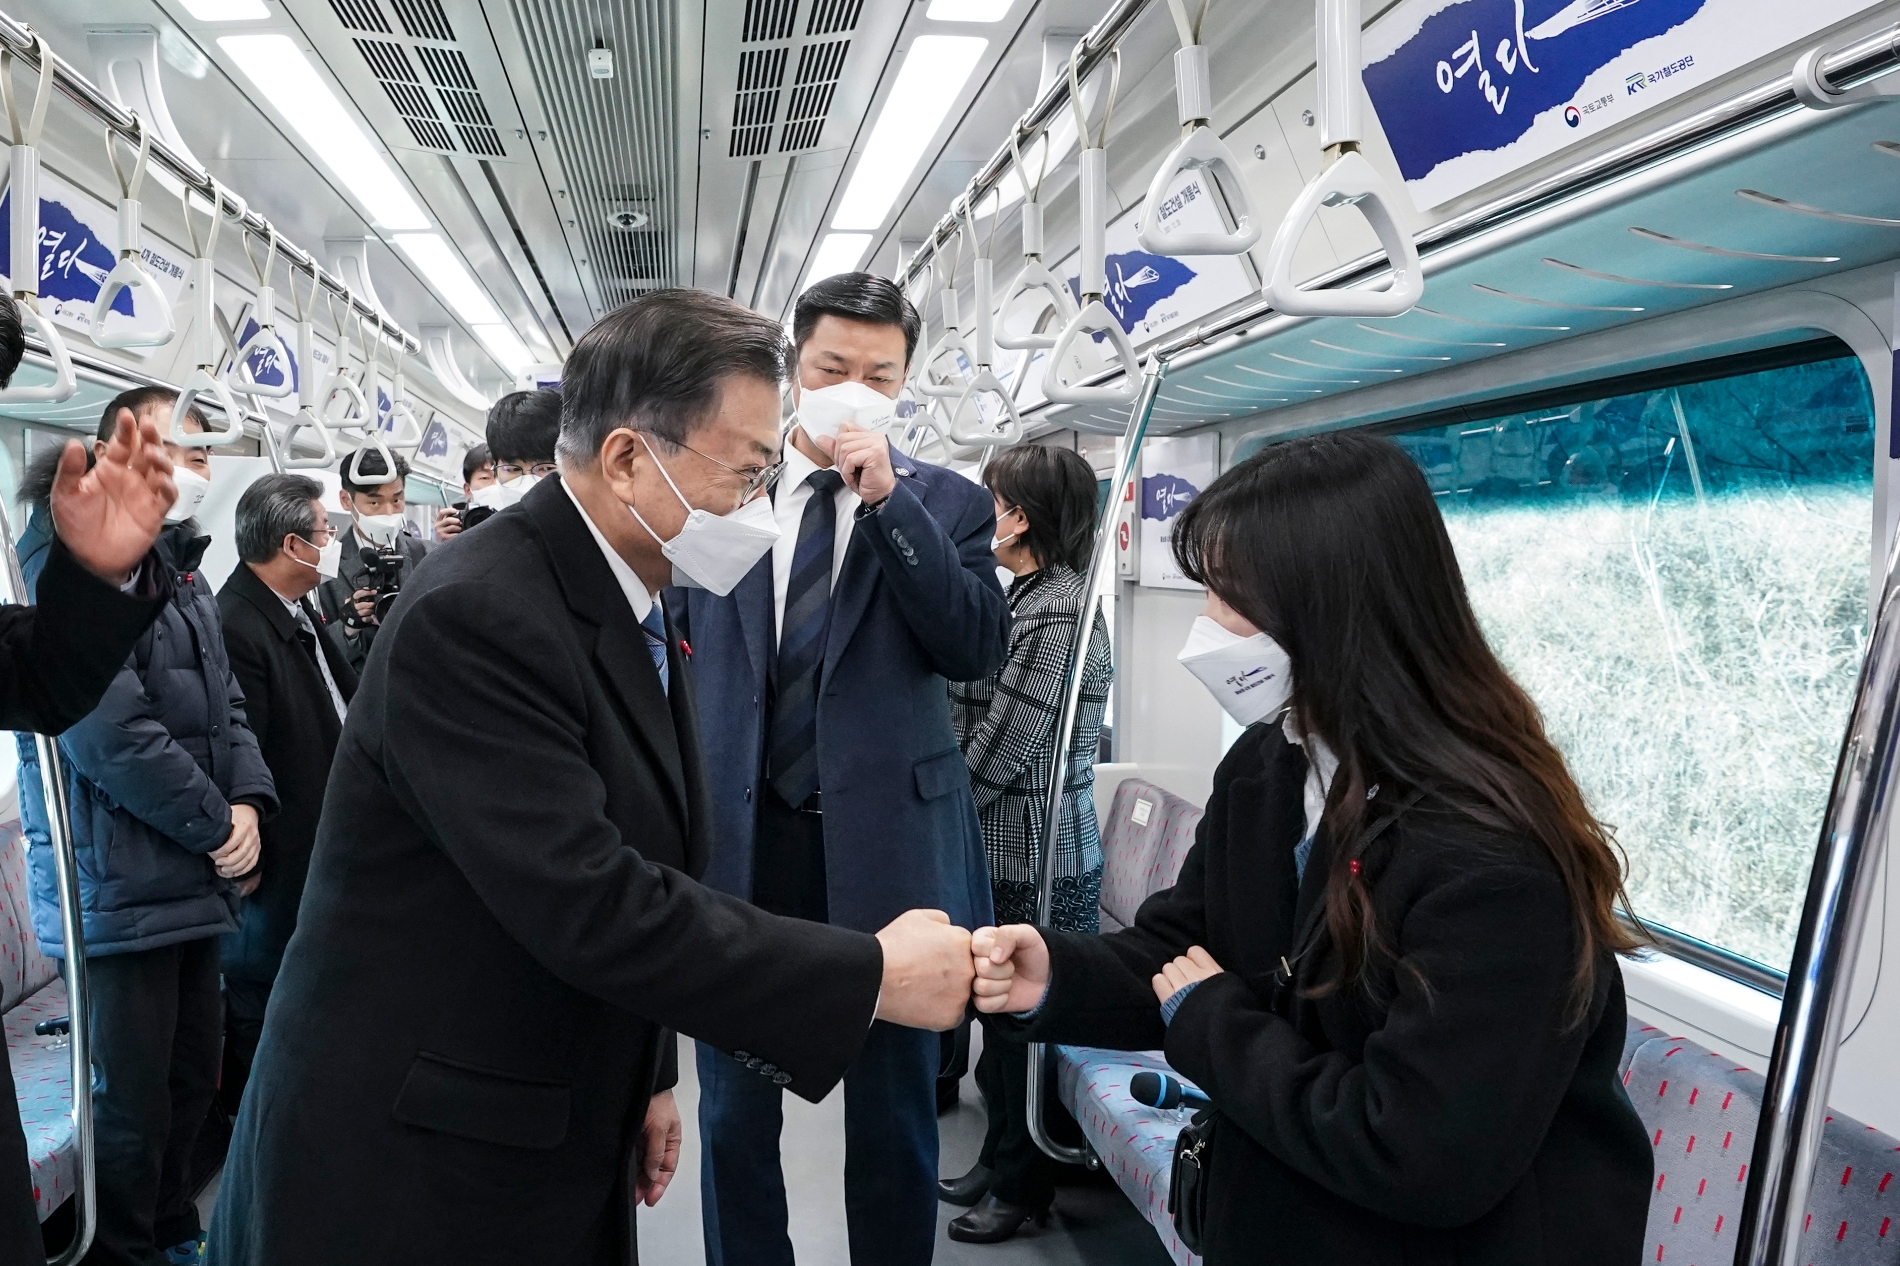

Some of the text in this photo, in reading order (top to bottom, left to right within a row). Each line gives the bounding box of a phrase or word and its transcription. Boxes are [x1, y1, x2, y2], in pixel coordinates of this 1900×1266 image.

[1436, 0, 1540, 115] 열다
[1646, 54, 1695, 84] 국가철도공단
[1581, 93, 1615, 116] 국토교통부
[1158, 180, 1202, 221] 철도건설 개통식
[38, 225, 88, 281] 열다
[148, 252, 171, 274] 철도건설
[167, 263, 185, 281] 개통식
[1155, 482, 1176, 515] 열다
